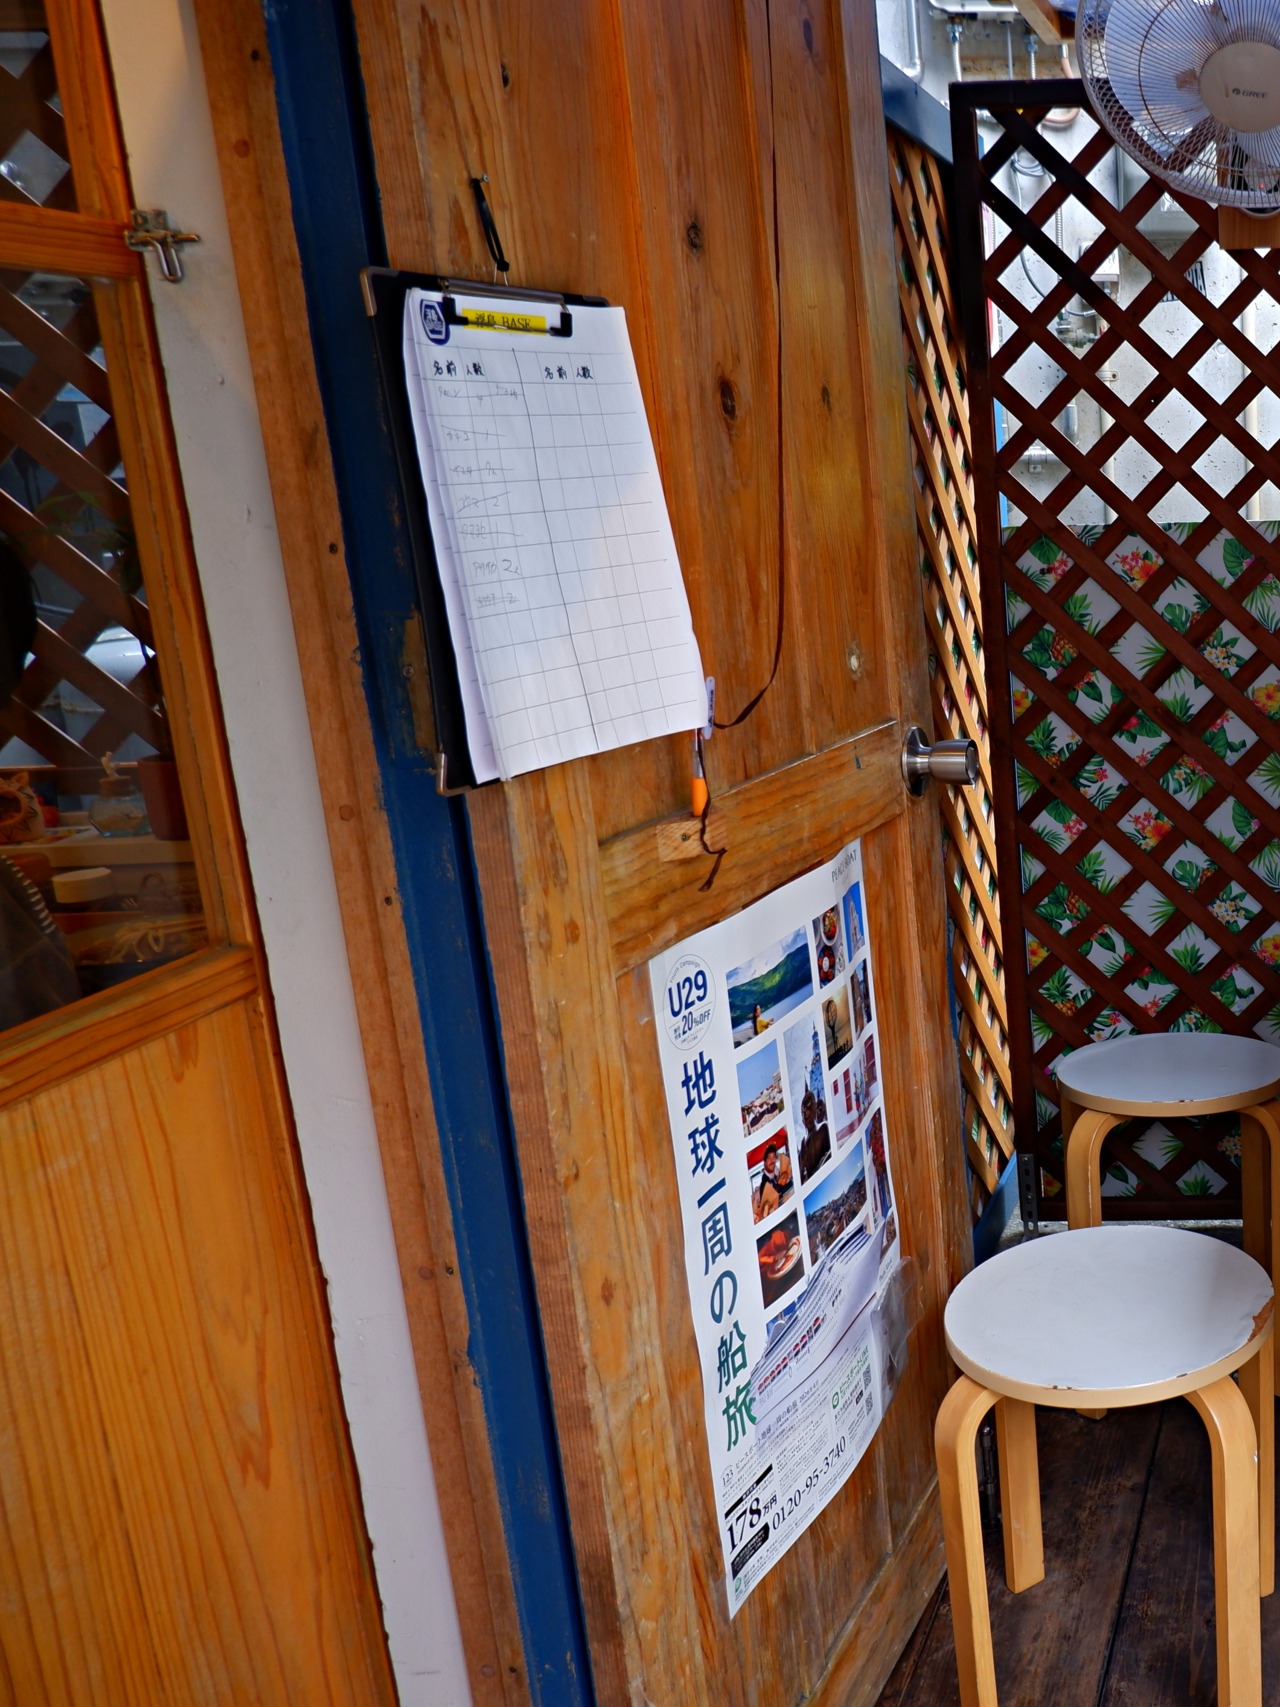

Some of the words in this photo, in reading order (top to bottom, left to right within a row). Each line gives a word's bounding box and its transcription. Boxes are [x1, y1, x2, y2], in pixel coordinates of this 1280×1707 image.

[502, 315, 532, 330] BASE
[433, 359, 457, 376] 名前
[466, 362, 485, 377] 人数
[544, 365, 568, 380] 名前
[576, 364, 594, 380] 人数
[668, 969, 708, 1018] U29
[681, 1050, 758, 1453] 地球一周の船旅
[772, 1435, 846, 1531] 0120-95-3740
